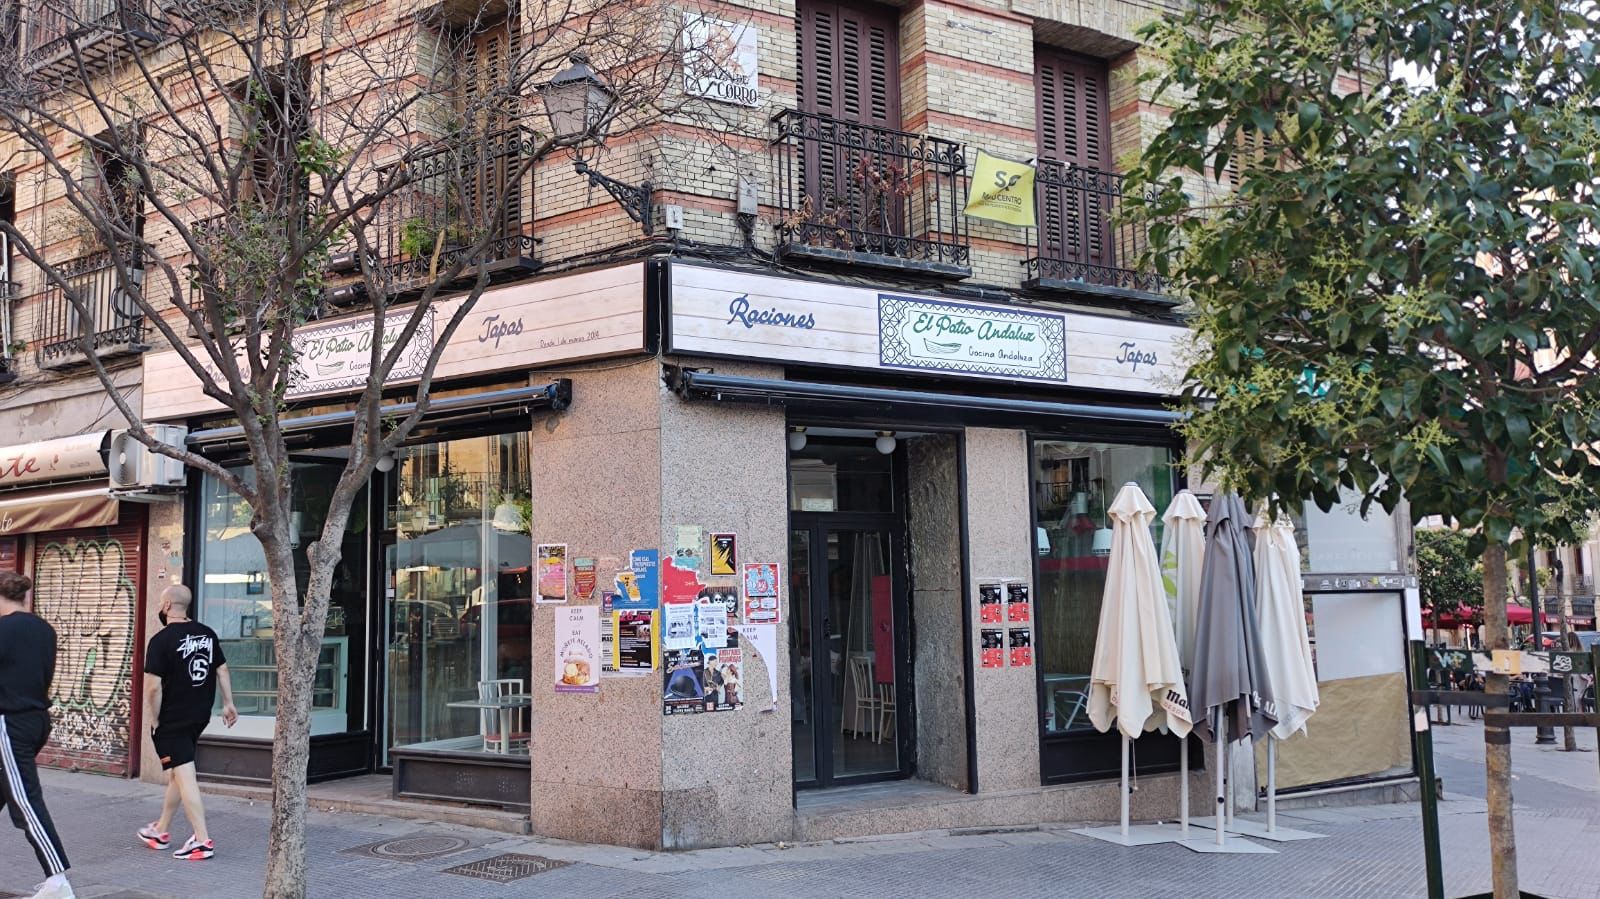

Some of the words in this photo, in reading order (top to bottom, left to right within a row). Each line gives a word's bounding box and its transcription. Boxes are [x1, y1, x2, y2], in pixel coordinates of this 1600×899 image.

[727, 294, 815, 329] Raciones
[479, 315, 523, 349] Tapas
[913, 313, 934, 333] El
[936, 314, 975, 336] Patio
[977, 320, 1036, 342] Andaluz
[308, 338, 324, 360] El
[326, 336, 355, 359] Patio
[968, 346, 995, 358] Cocina
[998, 349, 1033, 361] Andaluza
[1116, 341, 1158, 373] Tapas
